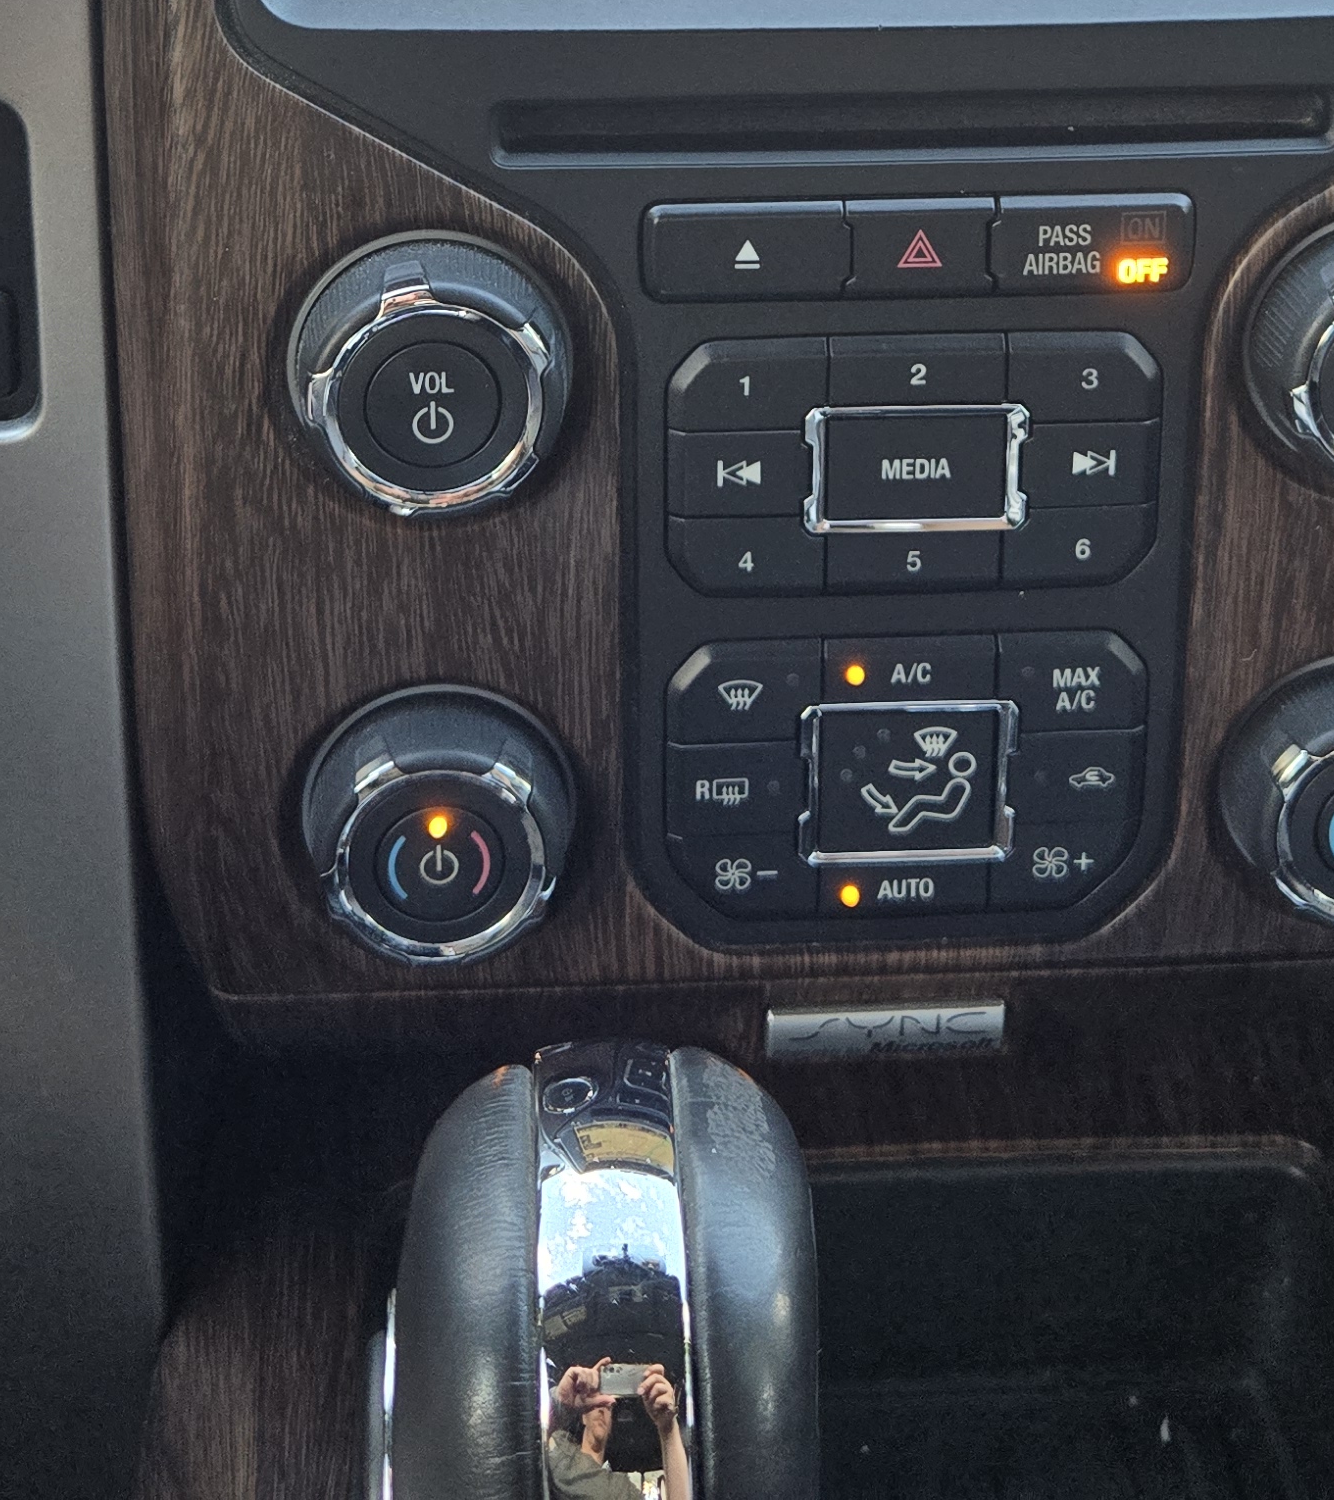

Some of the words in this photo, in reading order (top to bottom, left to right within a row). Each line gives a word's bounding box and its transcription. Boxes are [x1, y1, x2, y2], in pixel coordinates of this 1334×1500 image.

[1038, 224, 1092, 247] PASS
[1127, 217, 1160, 240] ON
[1022, 250, 1101, 275] AIRBAG
[1118, 256, 1169, 284] OFF
[409, 371, 455, 394] VOL
[739, 375, 751, 396] 1
[910, 363, 927, 385] 2
[1080, 368, 1099, 390] 3
[881, 456, 952, 481] MEDIA
[905, 549, 922, 572] 5
[1074, 538, 1091, 560] 6
[737, 550, 755, 572] 4
[890, 662, 932, 685] A/C
[1052, 666, 1100, 689] MAX
[1055, 689, 1096, 711] A/C
[877, 877, 935, 900] AUTO
[788, 1010, 987, 1041] SYNC
